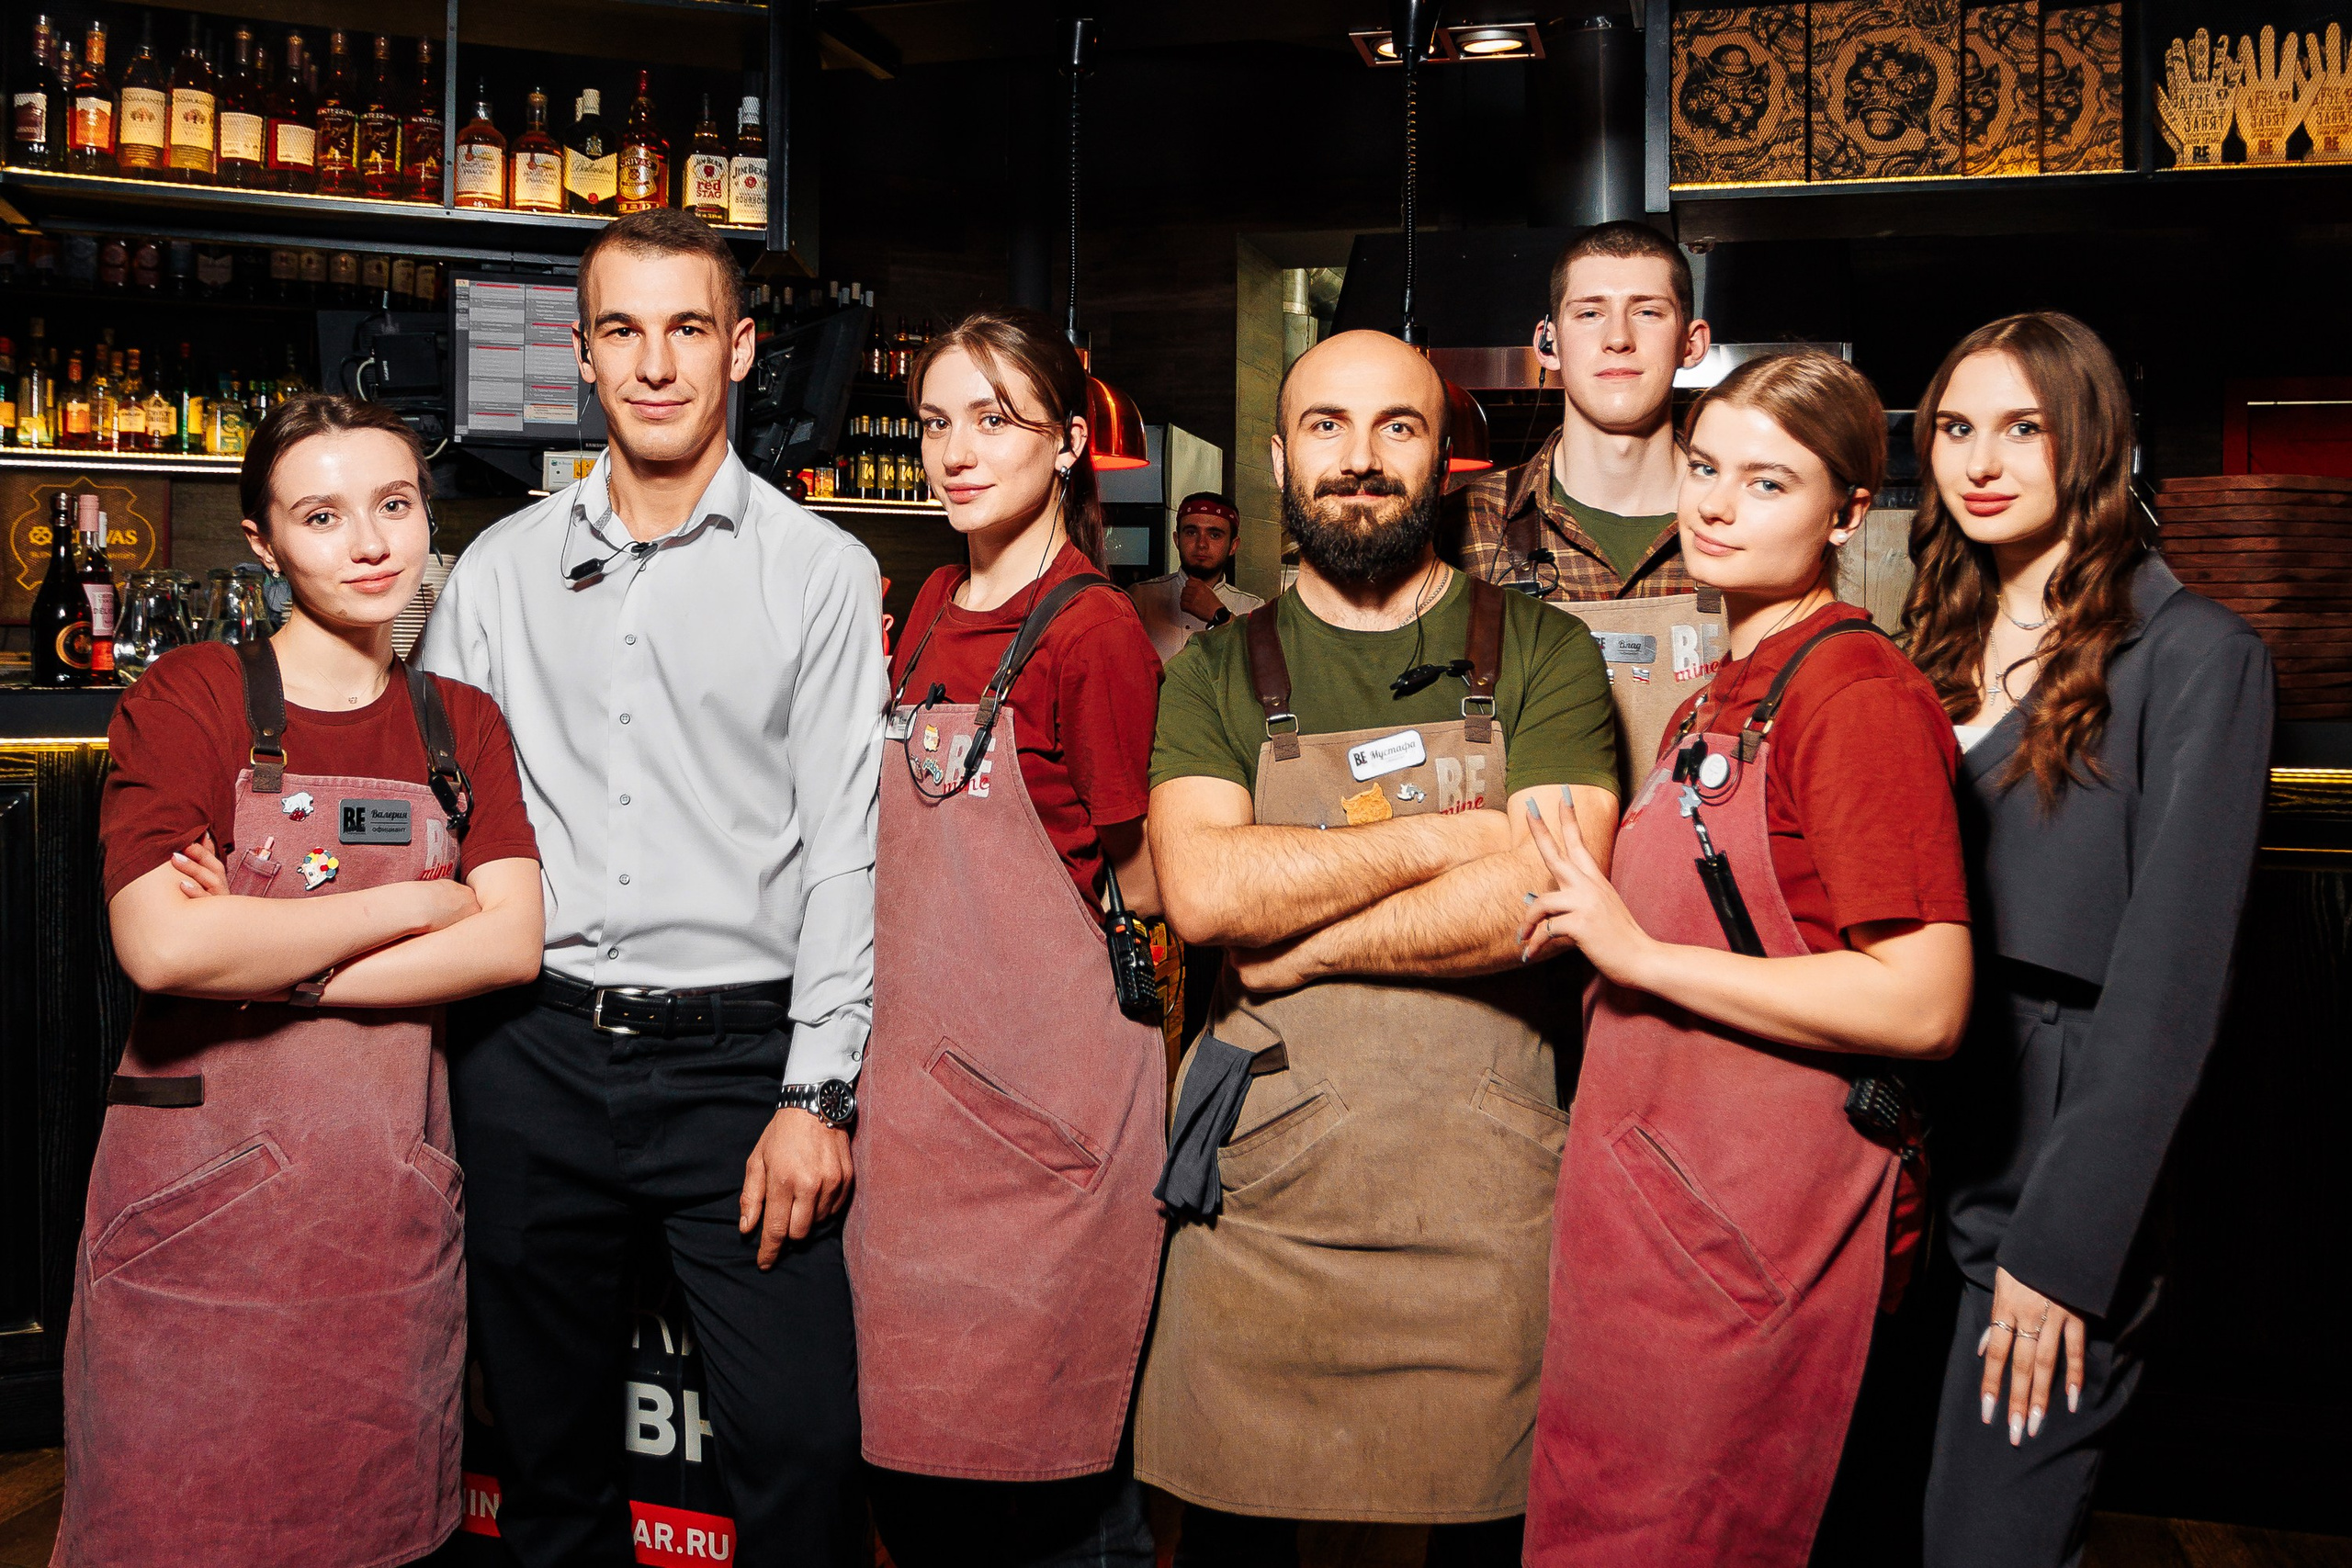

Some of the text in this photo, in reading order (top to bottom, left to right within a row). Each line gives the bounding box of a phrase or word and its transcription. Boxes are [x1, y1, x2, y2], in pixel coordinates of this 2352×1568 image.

[696, 180, 721, 191] red
[696, 189, 722, 198] STAG
[1673, 660, 1720, 682] mine
[1370, 741, 1416, 761] Мустафа
[371, 808, 408, 820] Валерия
